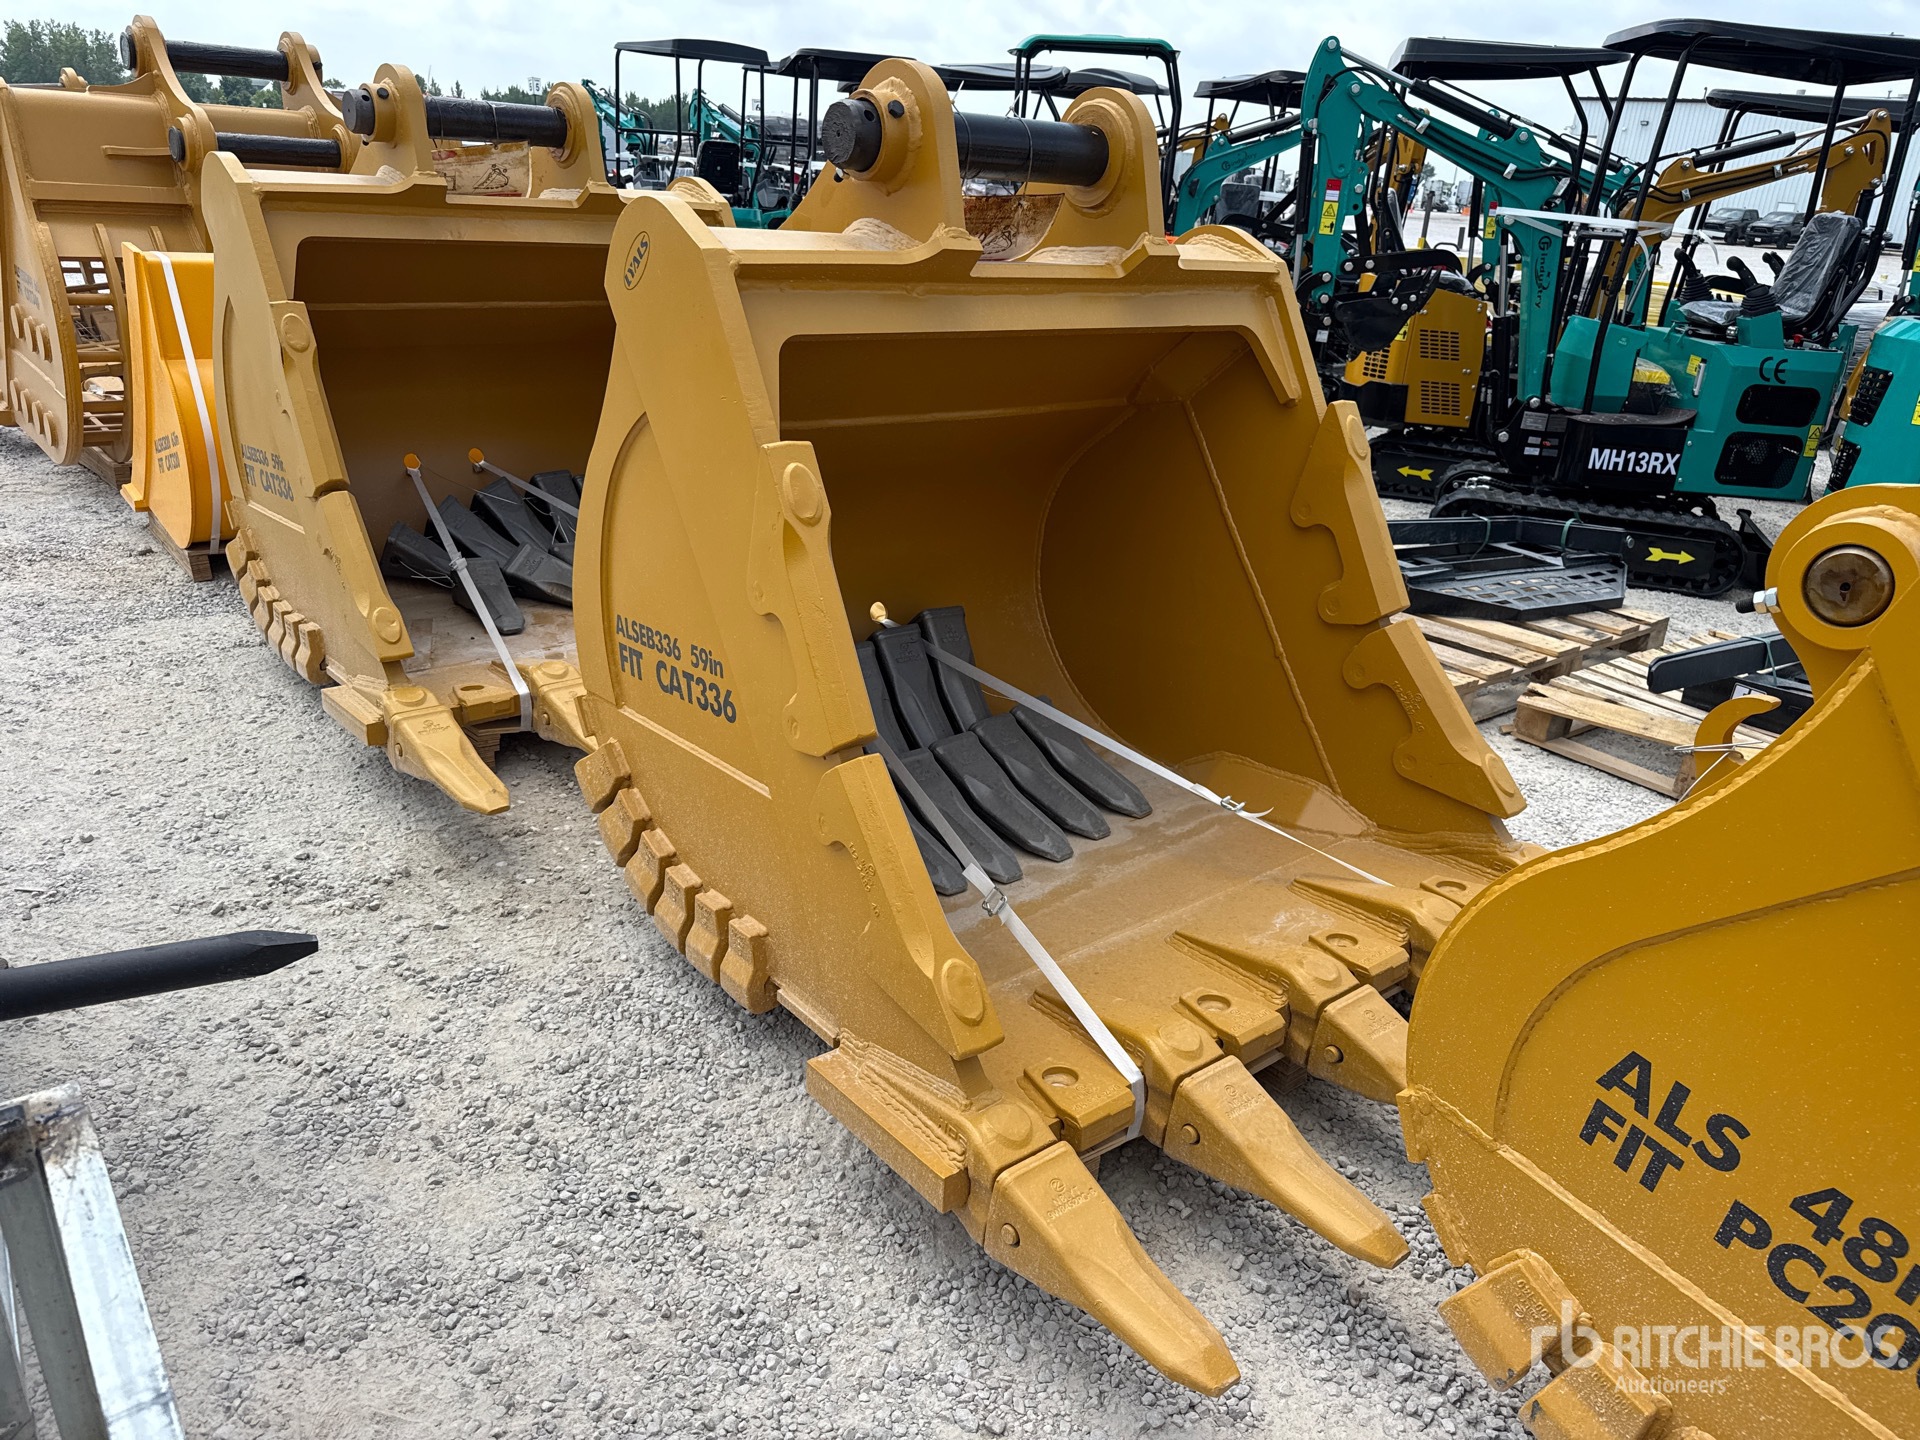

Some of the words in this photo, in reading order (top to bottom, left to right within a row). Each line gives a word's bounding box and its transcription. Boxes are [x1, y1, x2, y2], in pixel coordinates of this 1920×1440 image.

[1759, 356, 1789, 385] CE
[243, 462, 257, 487] FIT
[259, 469, 294, 502] CAT336
[1587, 447, 1681, 476] MH13RX
[616, 614, 682, 661] ALSEB336
[690, 644, 724, 679] 59in
[618, 641, 643, 681] FIT
[656, 660, 737, 724] CAT336
[1595, 1050, 1751, 1172] ALS
[1579, 1098, 1685, 1193] FIT
